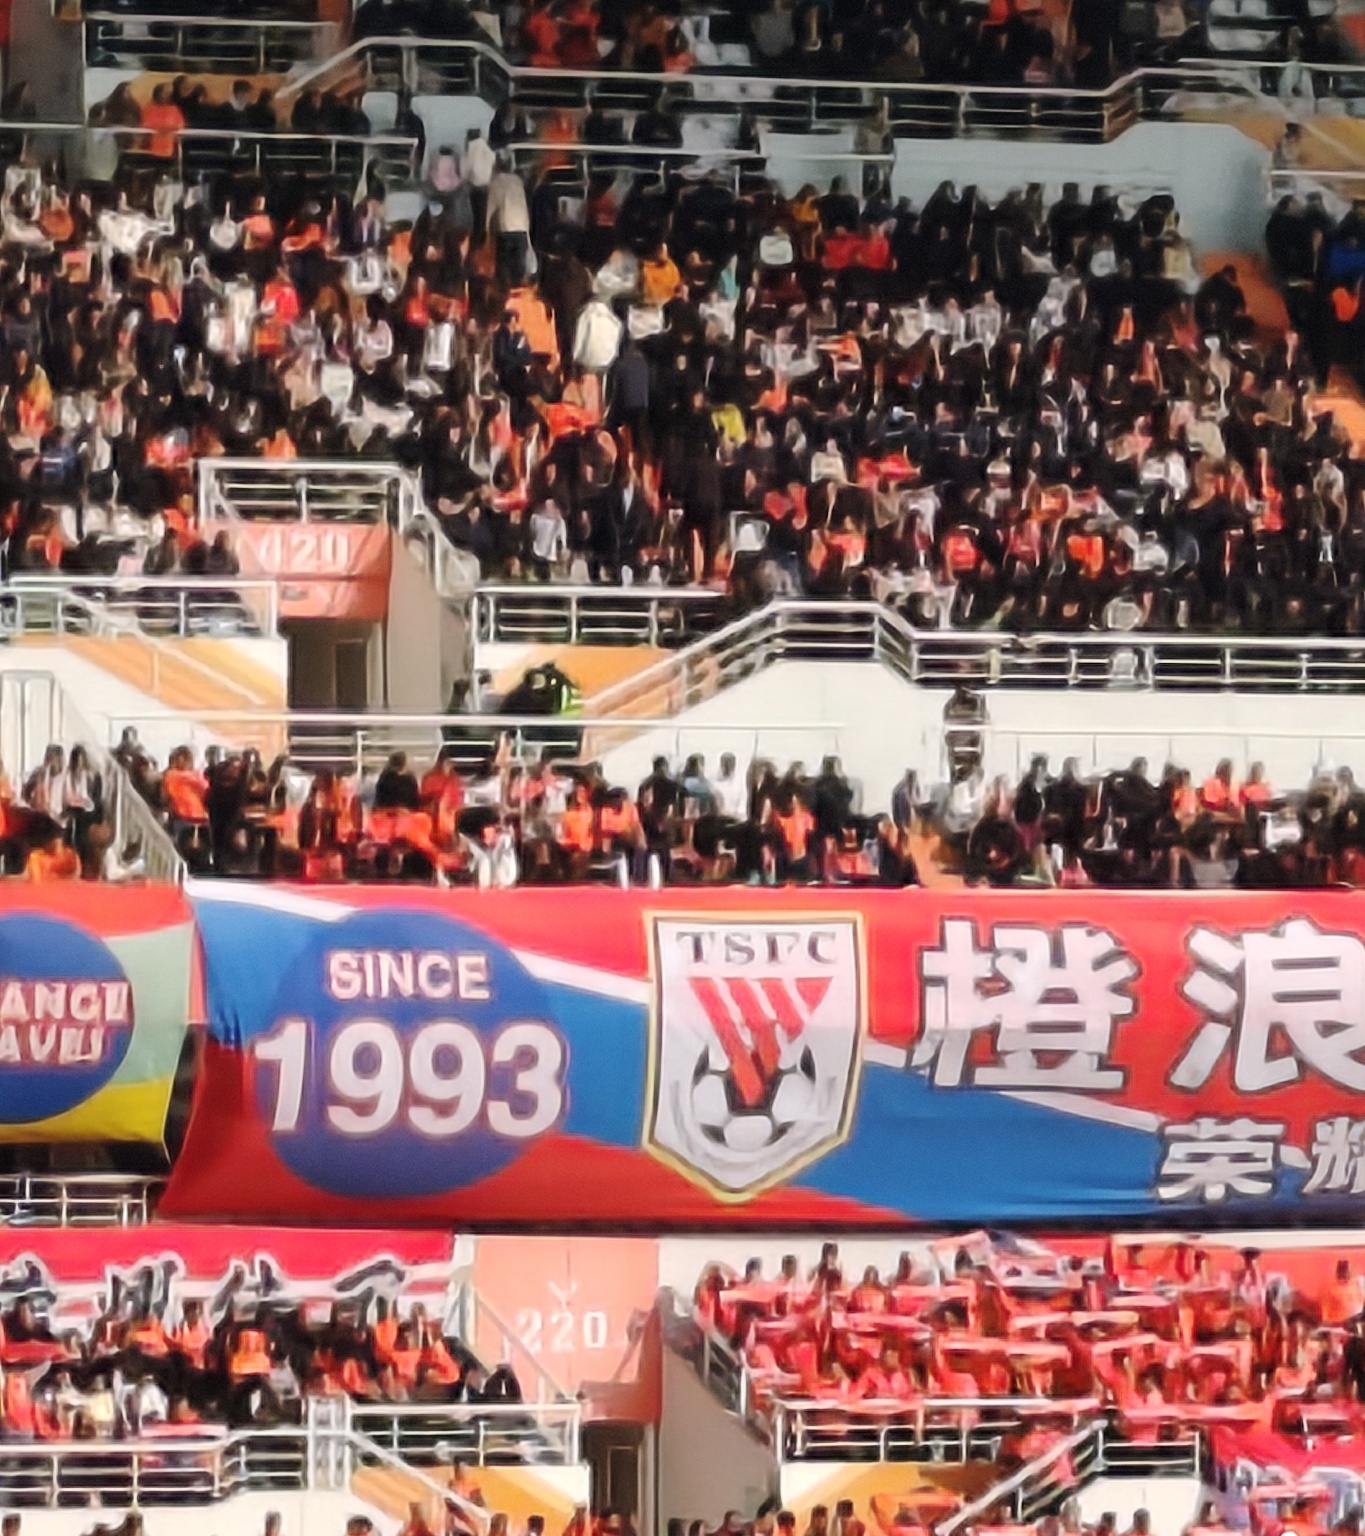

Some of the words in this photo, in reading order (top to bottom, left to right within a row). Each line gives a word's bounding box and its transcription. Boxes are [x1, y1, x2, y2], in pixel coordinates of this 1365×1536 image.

[329, 948, 490, 1000] SINCE
[253, 1019, 568, 1139] 1993
[517, 1307, 608, 1350] 220
